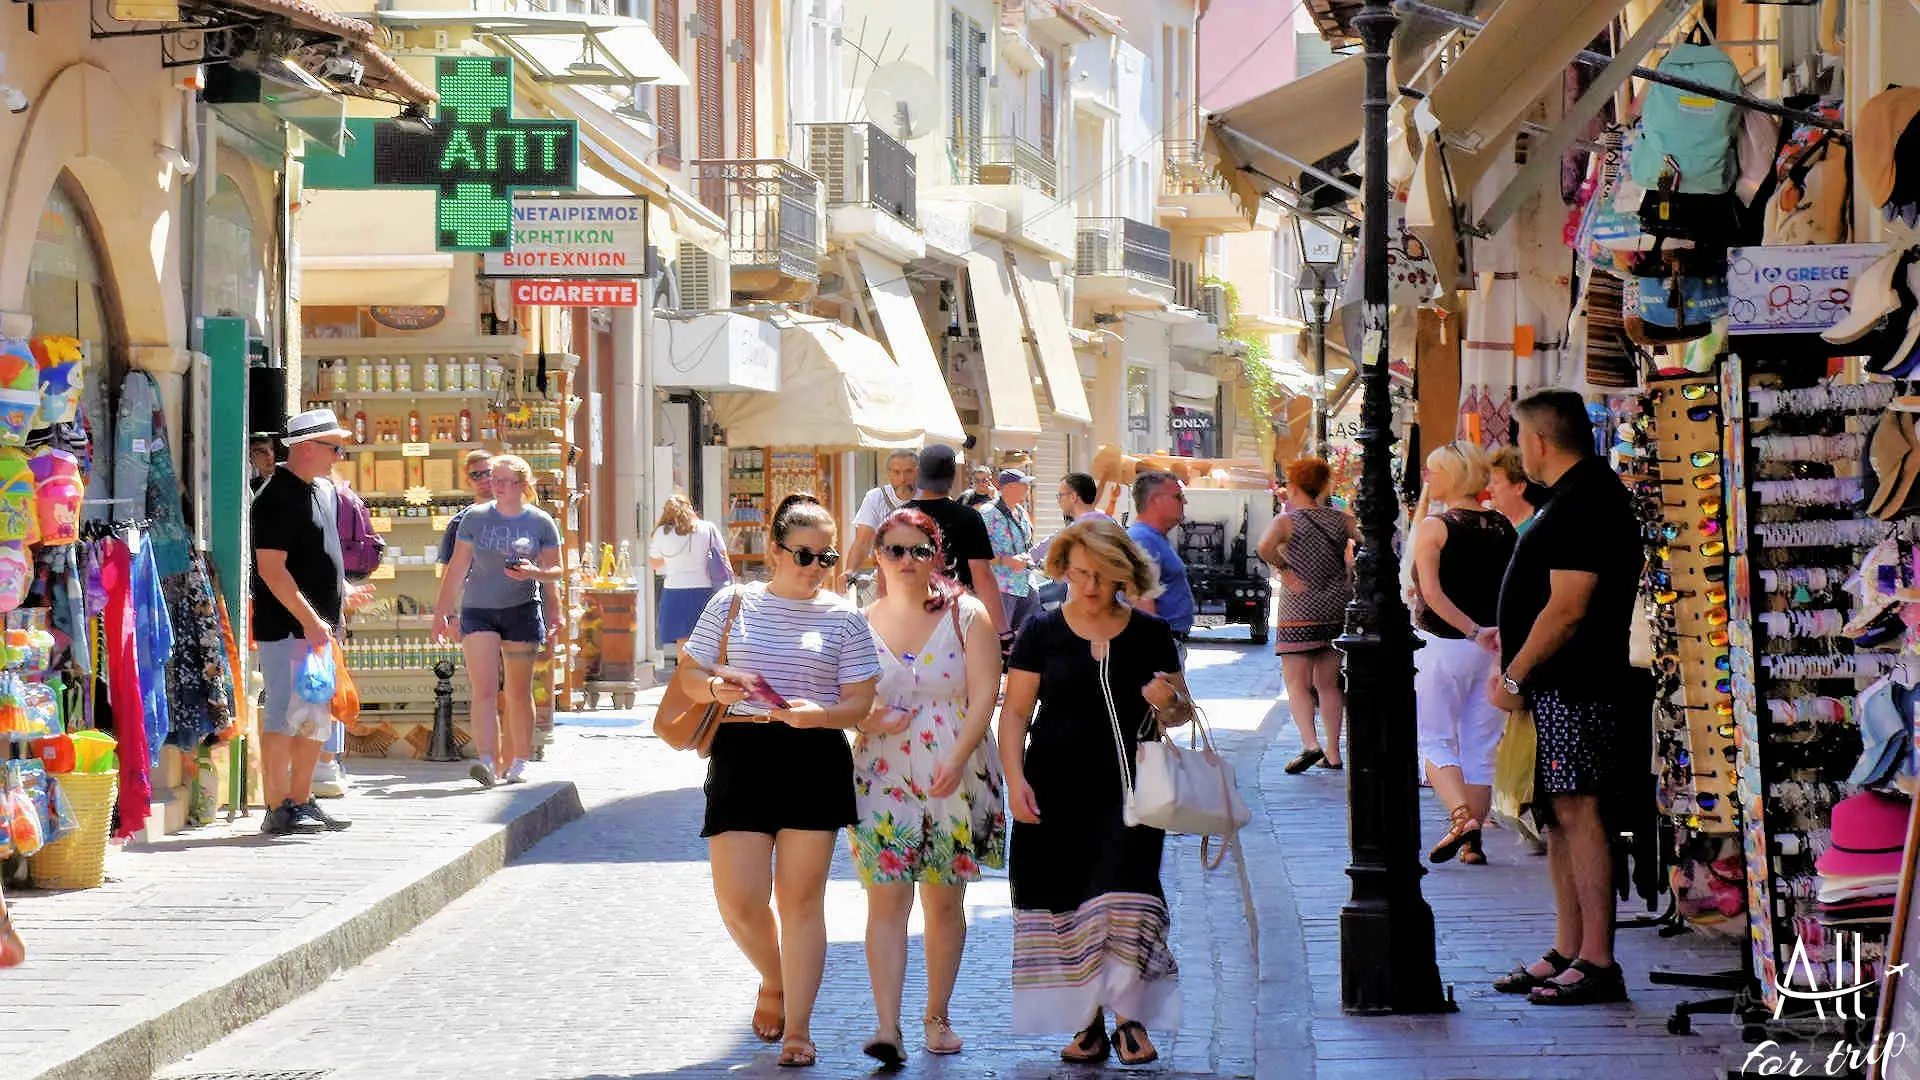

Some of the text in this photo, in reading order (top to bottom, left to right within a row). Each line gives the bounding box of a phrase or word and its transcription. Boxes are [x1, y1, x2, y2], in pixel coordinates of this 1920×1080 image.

[514, 207, 638, 221] ΝΕΤΑΙΡΙΣΜΟΣ
[503, 252, 626, 267] ΒΙΟΤΕΧΝΙΩΝ
[1786, 266, 1849, 281] GREECE
[518, 285, 633, 302] CIGARETTE
[1172, 418, 1208, 429] ONLY
